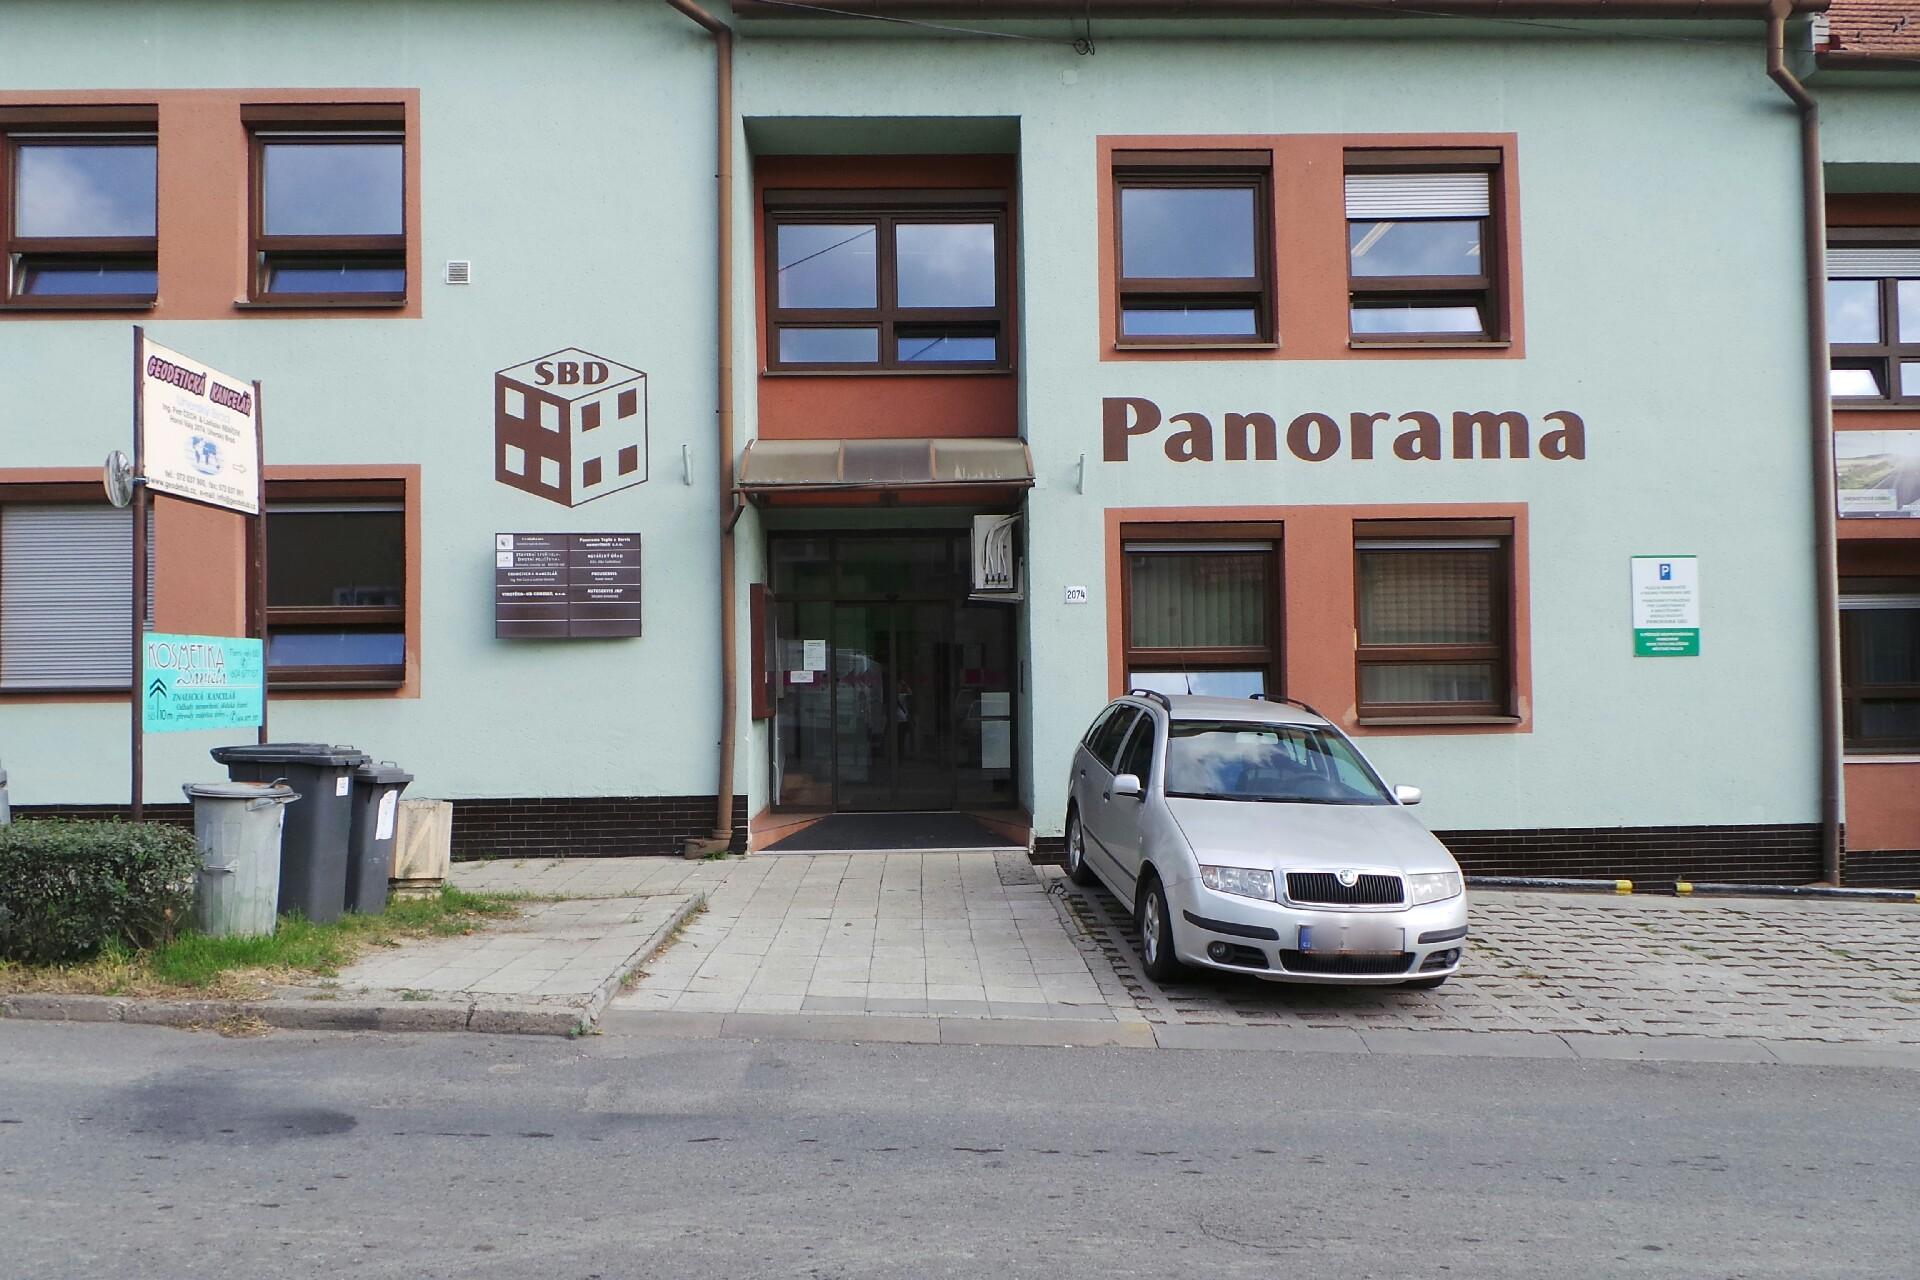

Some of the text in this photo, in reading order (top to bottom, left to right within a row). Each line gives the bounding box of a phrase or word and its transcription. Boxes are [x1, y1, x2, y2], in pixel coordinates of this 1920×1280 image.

[534, 361, 609, 386] SBD
[148, 356, 251, 417] GEODETICKÁ KANCELÁŘ
[1102, 397, 1585, 462] Panorama
[1067, 590, 1086, 600] 2074
[148, 643, 224, 668] KOSMETIKA
